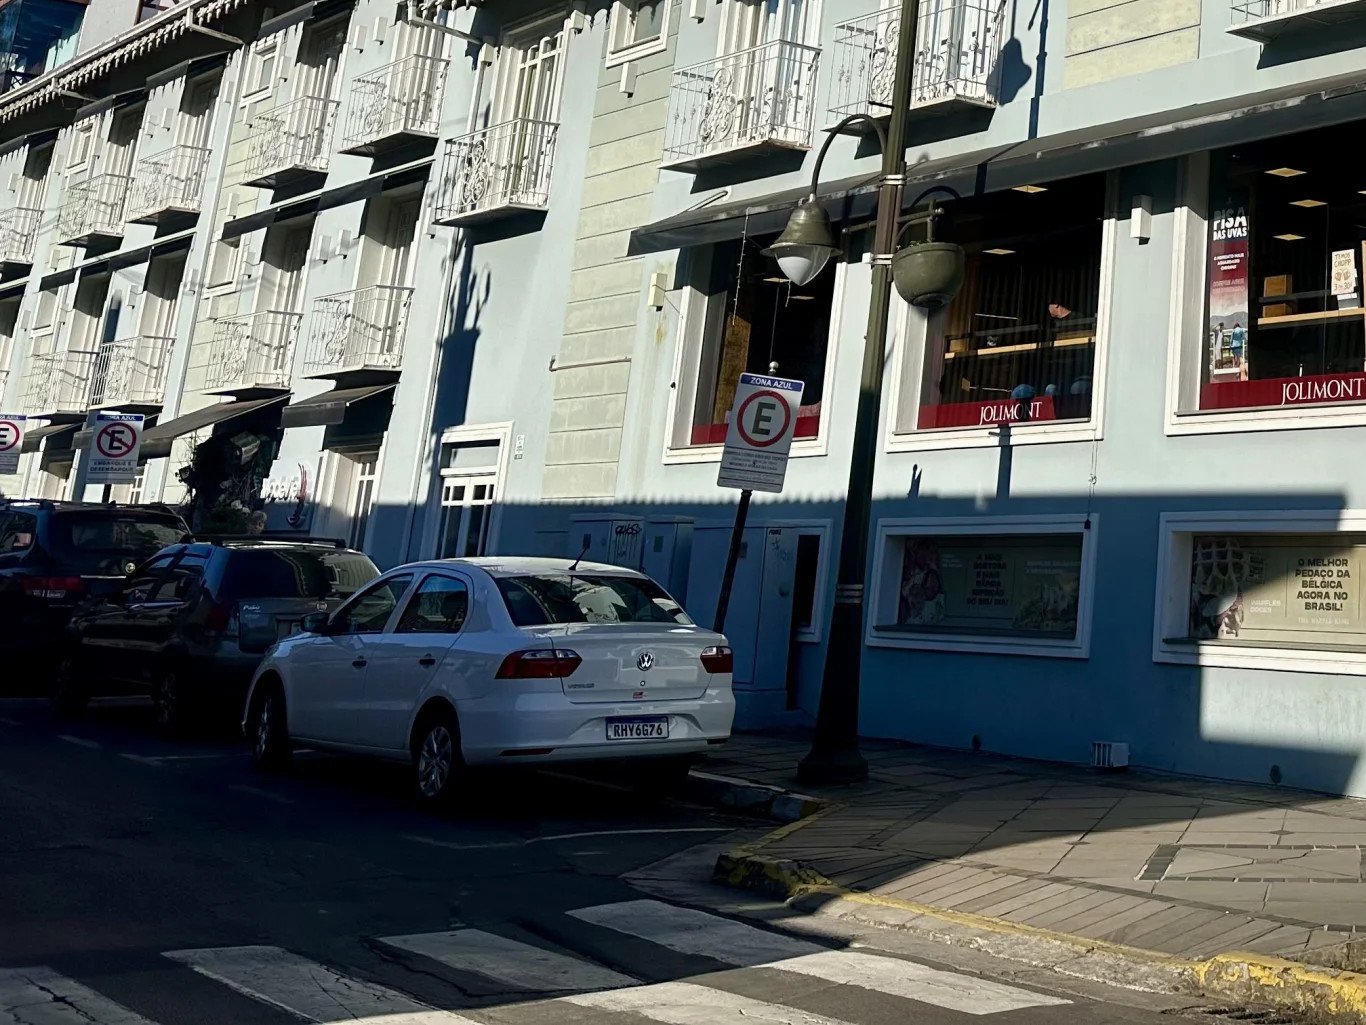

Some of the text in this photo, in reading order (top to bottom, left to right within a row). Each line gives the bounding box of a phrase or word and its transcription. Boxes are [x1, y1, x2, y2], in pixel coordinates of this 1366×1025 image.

[1227, 227, 1247, 238] UVAS
[750, 377, 792, 389] ZONA AZUL
[1281, 377, 1365, 405] JOLIMONT
[752, 402, 776, 435] E
[979, 402, 1042, 425] JOLIMONT
[108, 430, 125, 450] E
[1298, 558, 1348, 567] O MELHOR
[1295, 569, 1350, 579] PEDAÇO DA
[1301, 578, 1342, 589] BÉLGICA
[1296, 591, 1348, 600] AGORA NO
[1304, 602, 1343, 611] BRASIL!
[614, 724, 662, 737] RHY6G76
